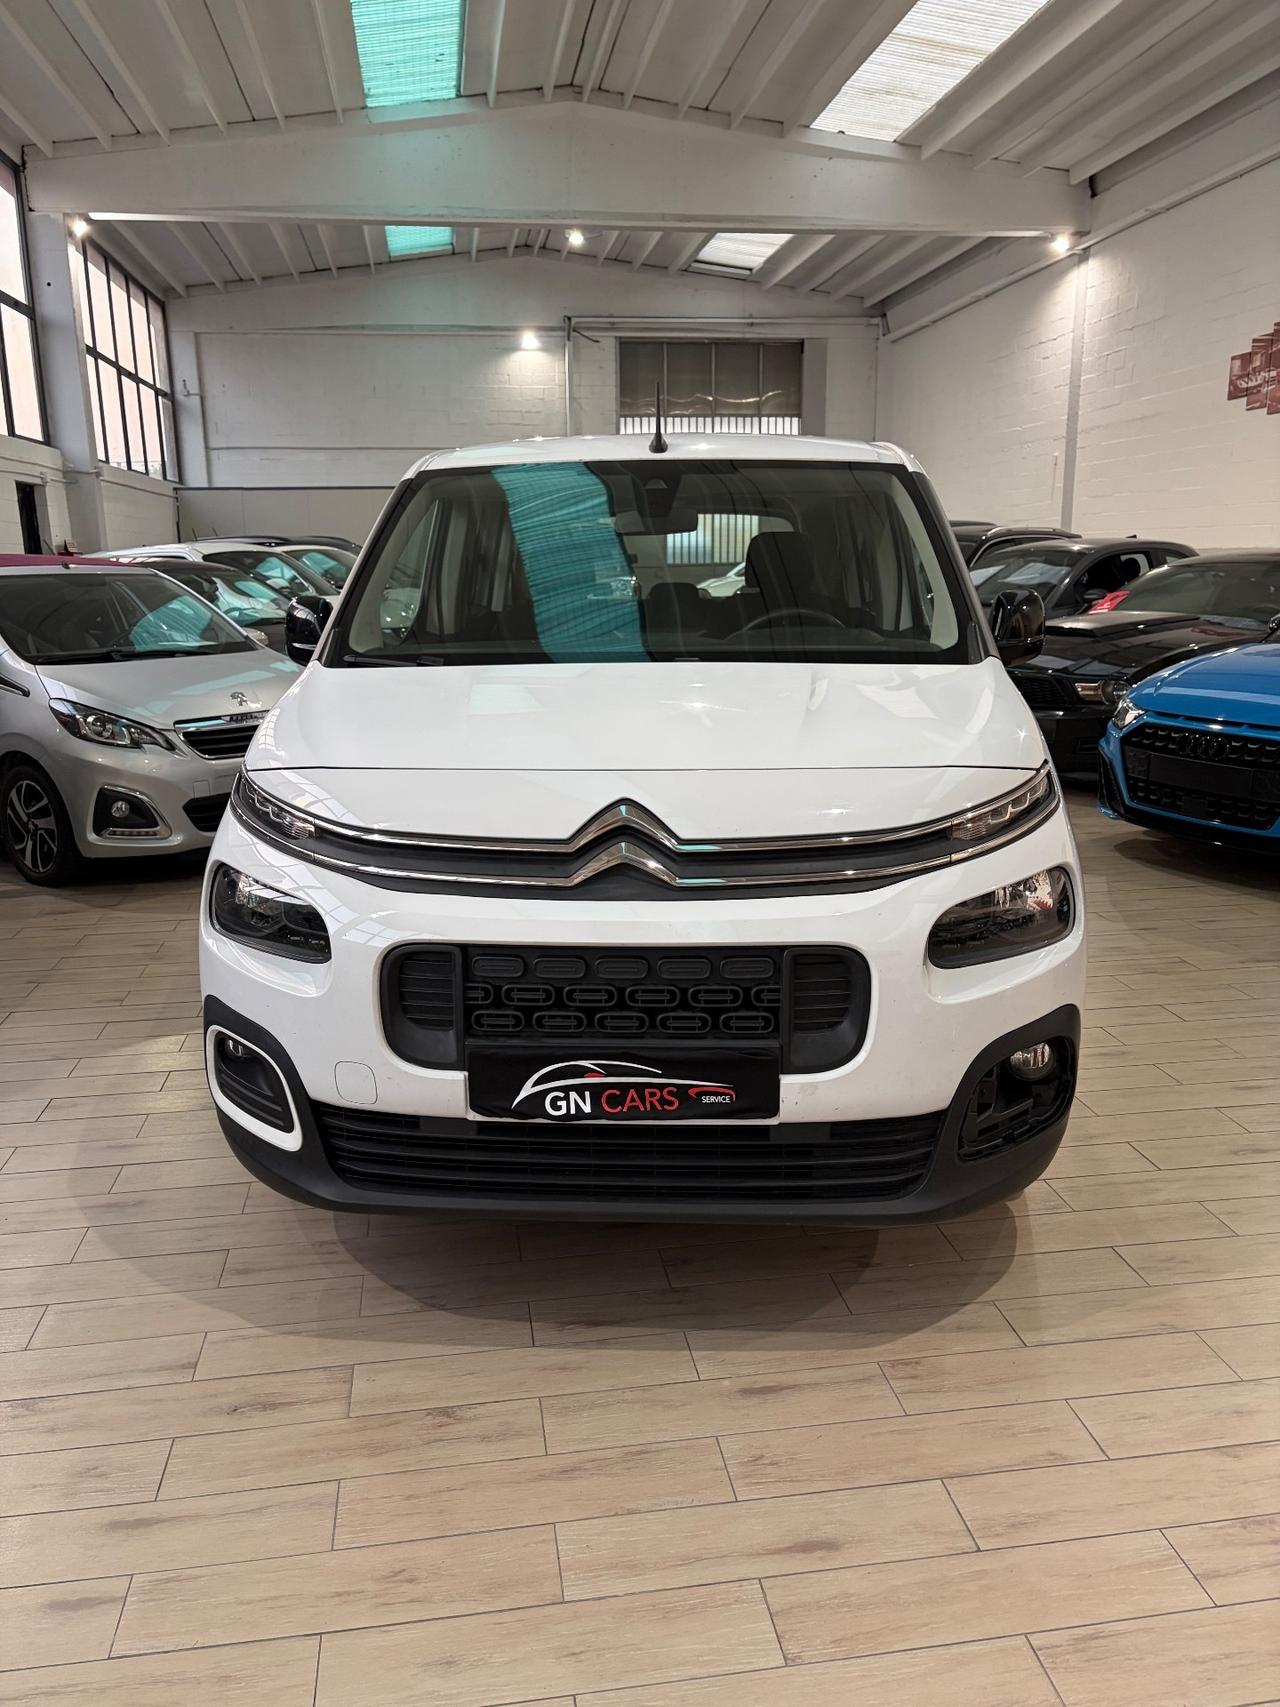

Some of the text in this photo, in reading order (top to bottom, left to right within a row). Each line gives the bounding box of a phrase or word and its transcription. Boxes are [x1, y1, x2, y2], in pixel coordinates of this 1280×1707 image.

[545, 1087, 731, 1116] GN CARS SERVICE
